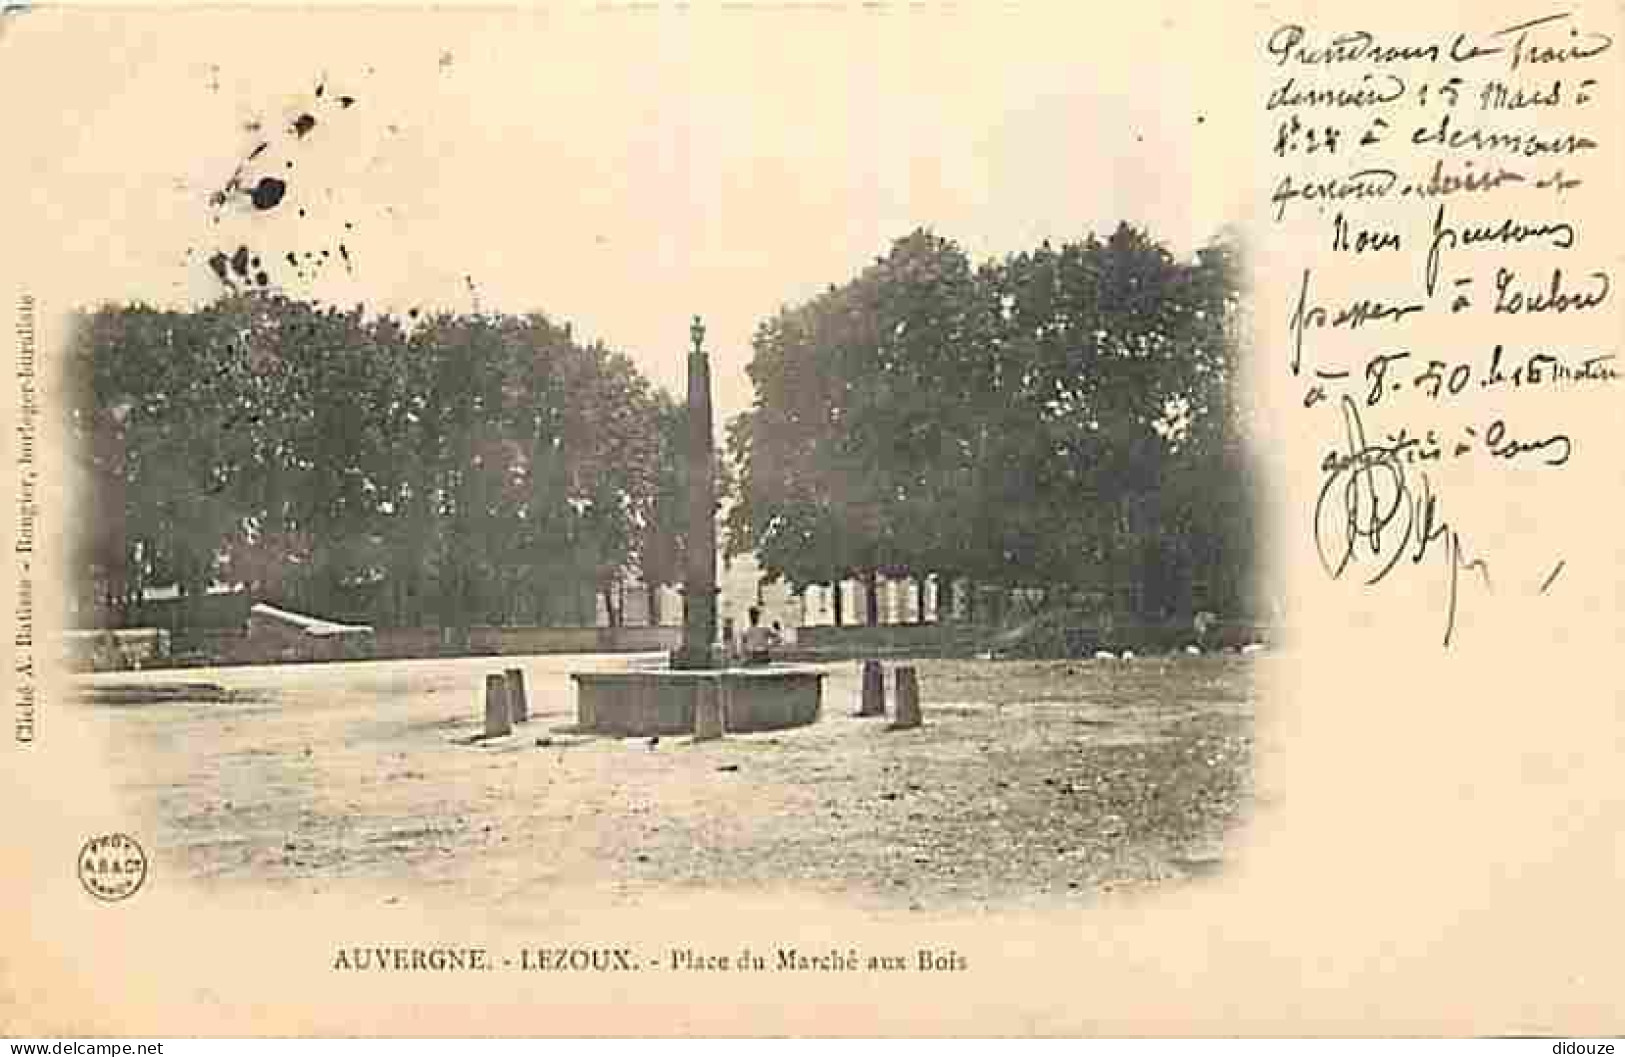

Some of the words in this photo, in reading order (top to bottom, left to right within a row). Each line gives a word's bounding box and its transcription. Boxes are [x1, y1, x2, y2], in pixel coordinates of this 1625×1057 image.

[520, 948, 641, 971] LEZOUX.
[671, 949, 730, 971] Place
[736, 948, 764, 971] du
[776, 948, 858, 971] Marché
[867, 955, 907, 971] aux
[917, 949, 968, 971] Bois
